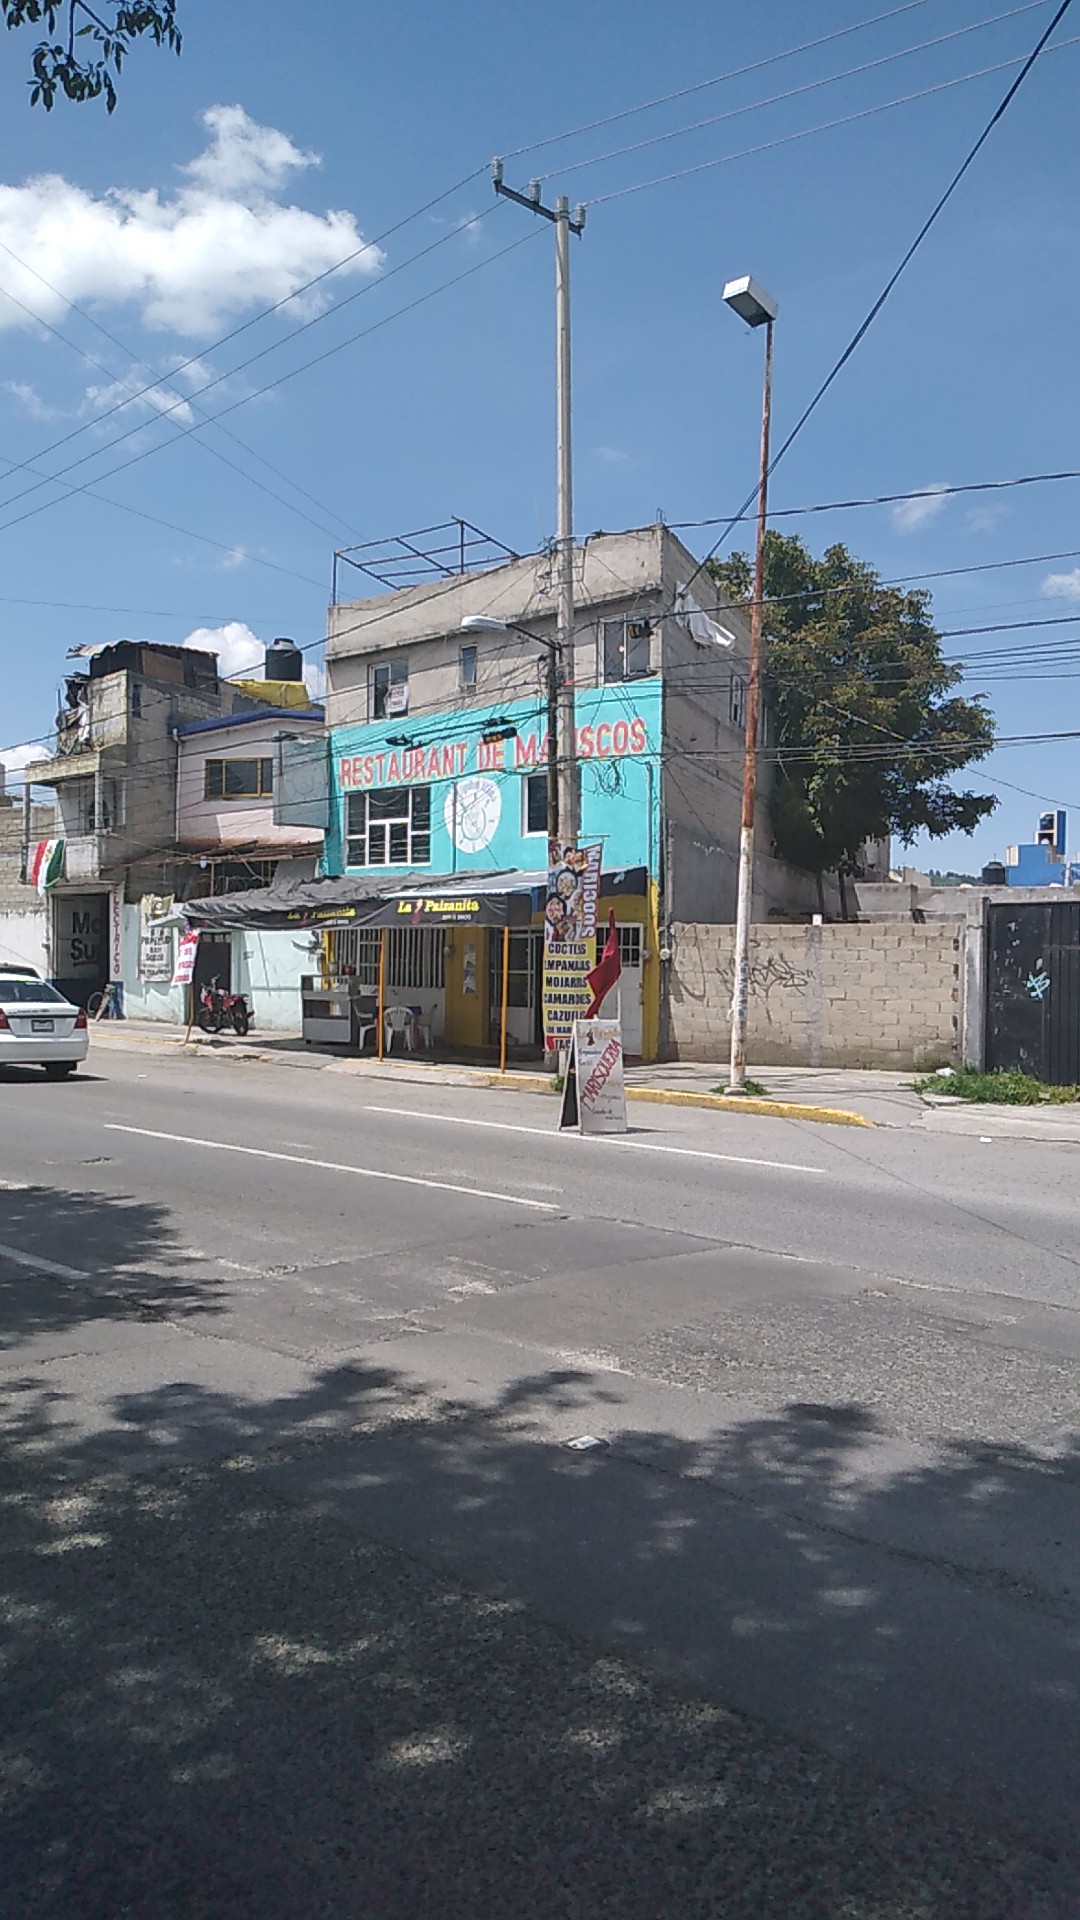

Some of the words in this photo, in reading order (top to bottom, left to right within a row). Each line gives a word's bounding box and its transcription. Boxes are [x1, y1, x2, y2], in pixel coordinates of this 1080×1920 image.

[339, 742, 468, 787] RESTAURANT
[478, 737, 505, 769] DE
[515, 717, 646, 766] MAISCOS
[580, 1038, 623, 1113] MARISQUERIA
